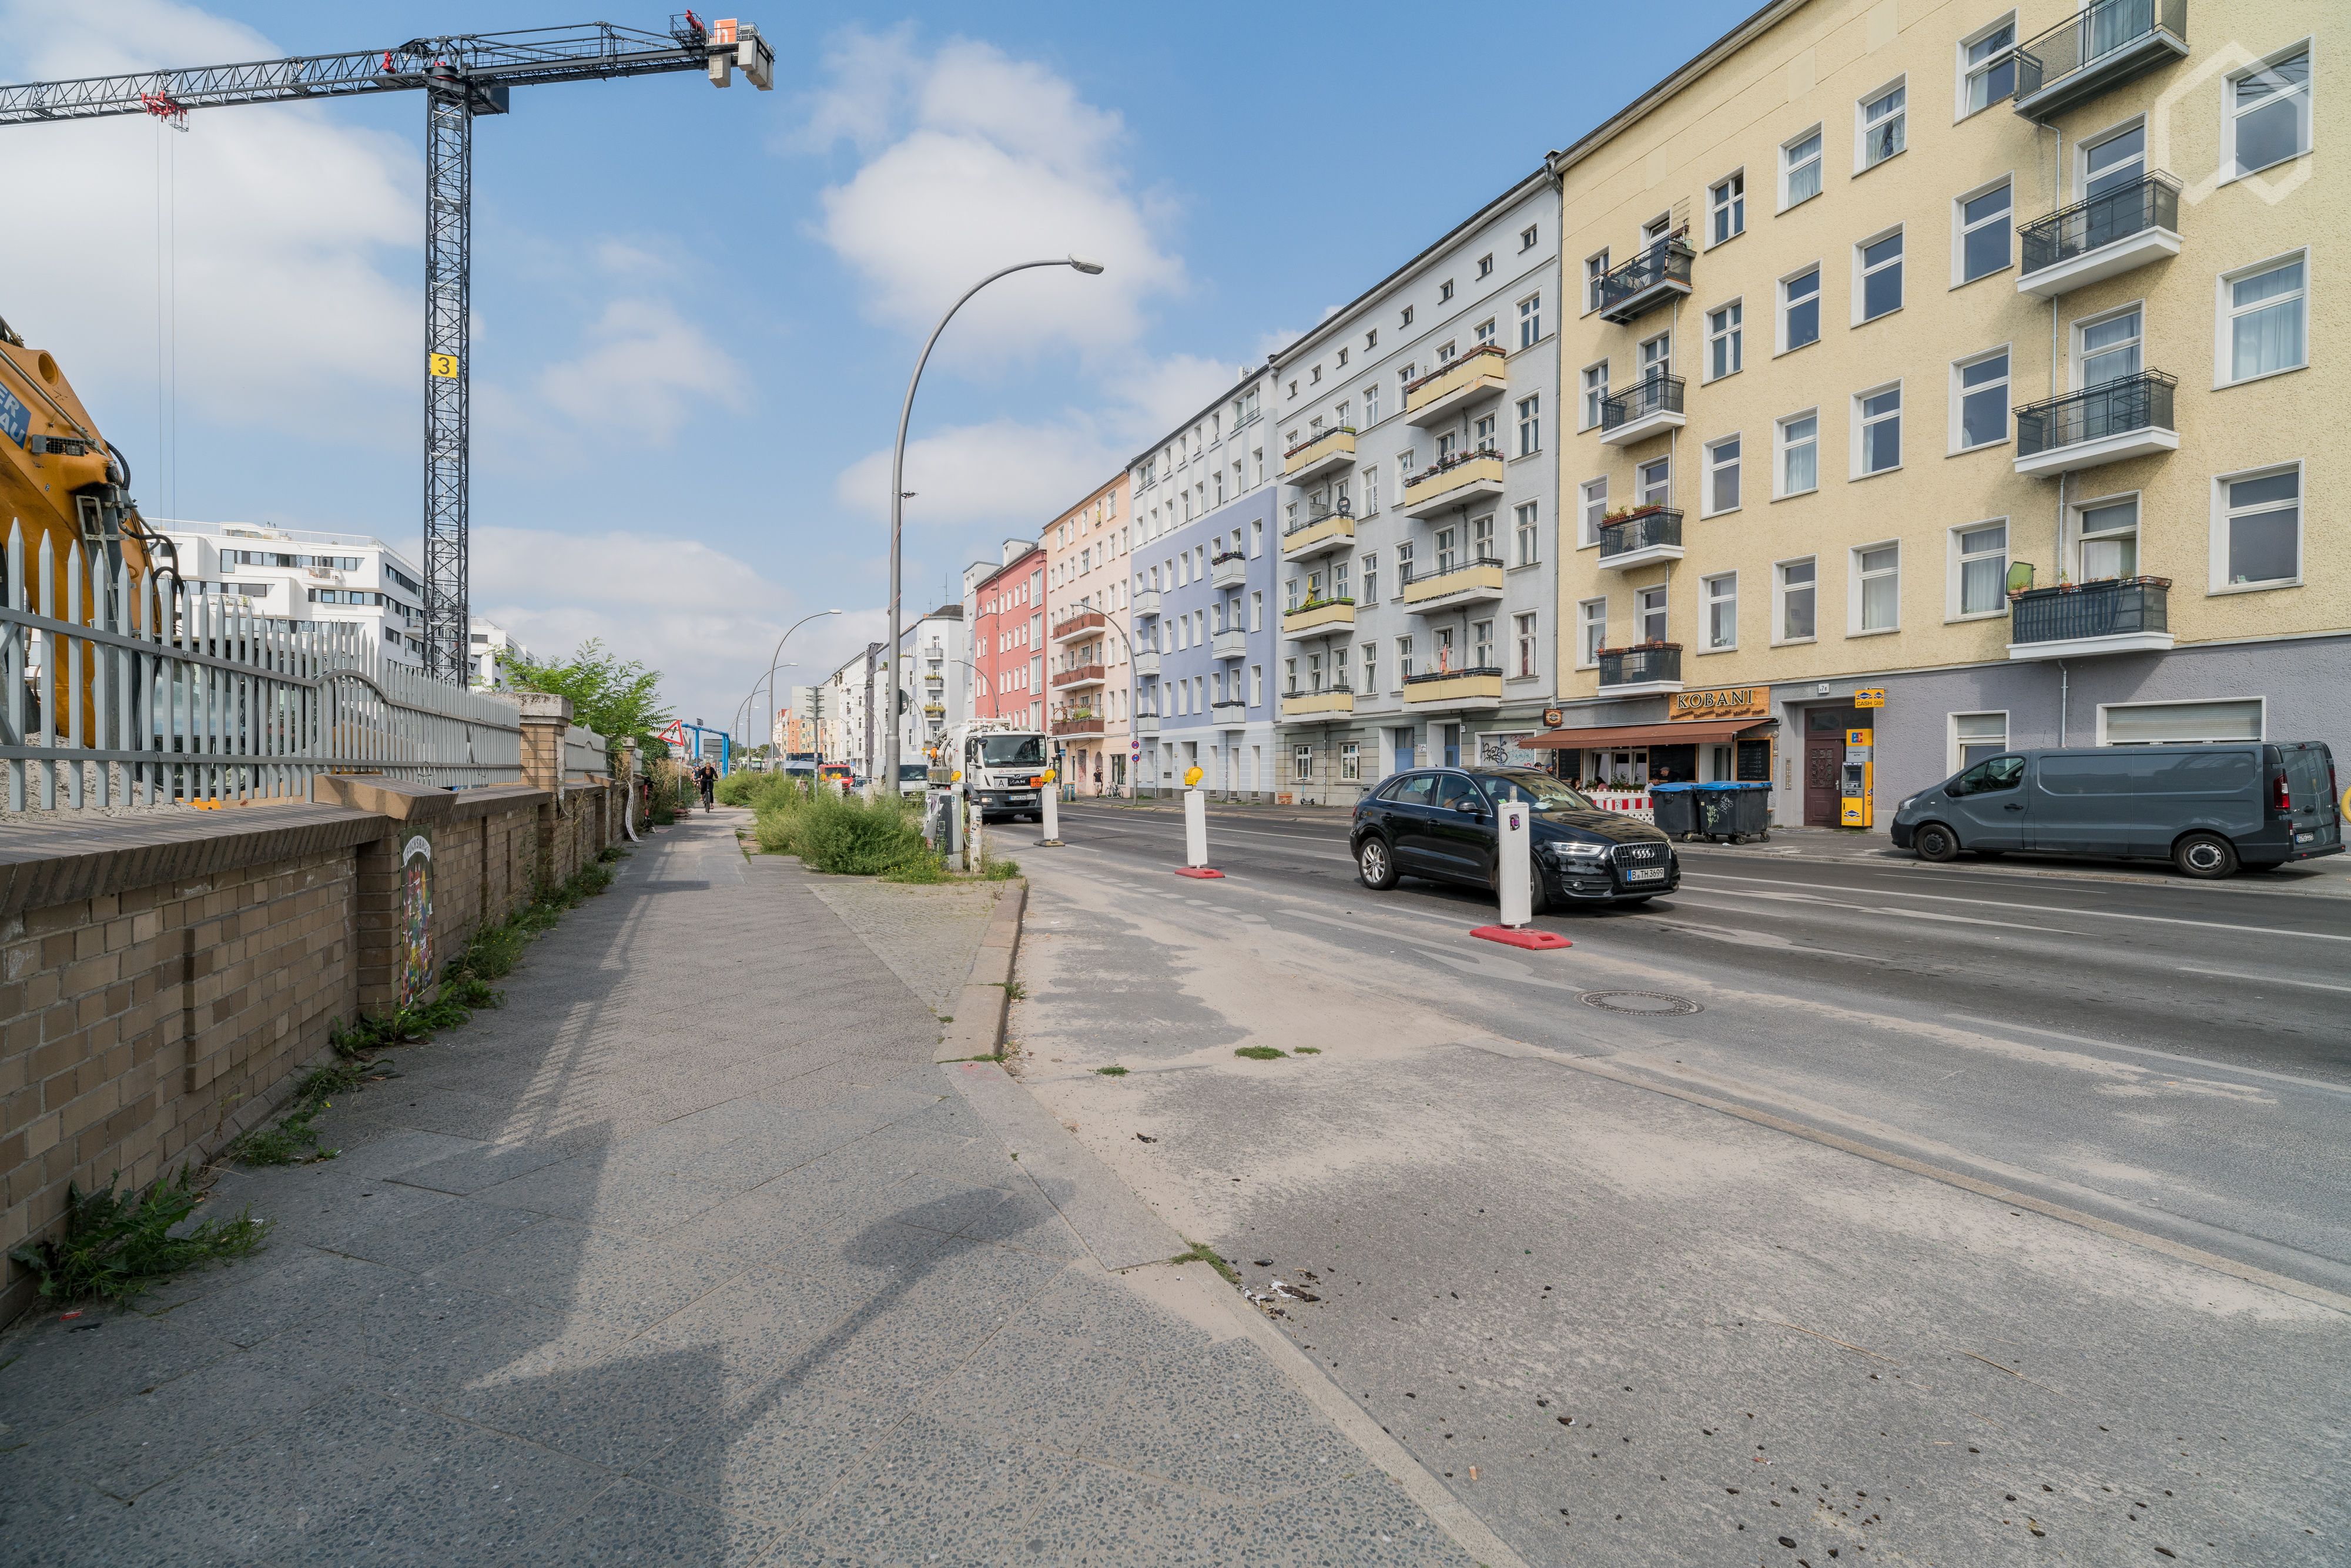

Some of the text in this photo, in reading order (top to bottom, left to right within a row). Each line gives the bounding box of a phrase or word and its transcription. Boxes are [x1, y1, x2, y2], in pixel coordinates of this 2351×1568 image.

[717, 23, 728, 43] h
[438, 357, 450, 374] 3
[1677, 689, 1753, 709] KOBANI
[1649, 869, 1663, 877] 3699
